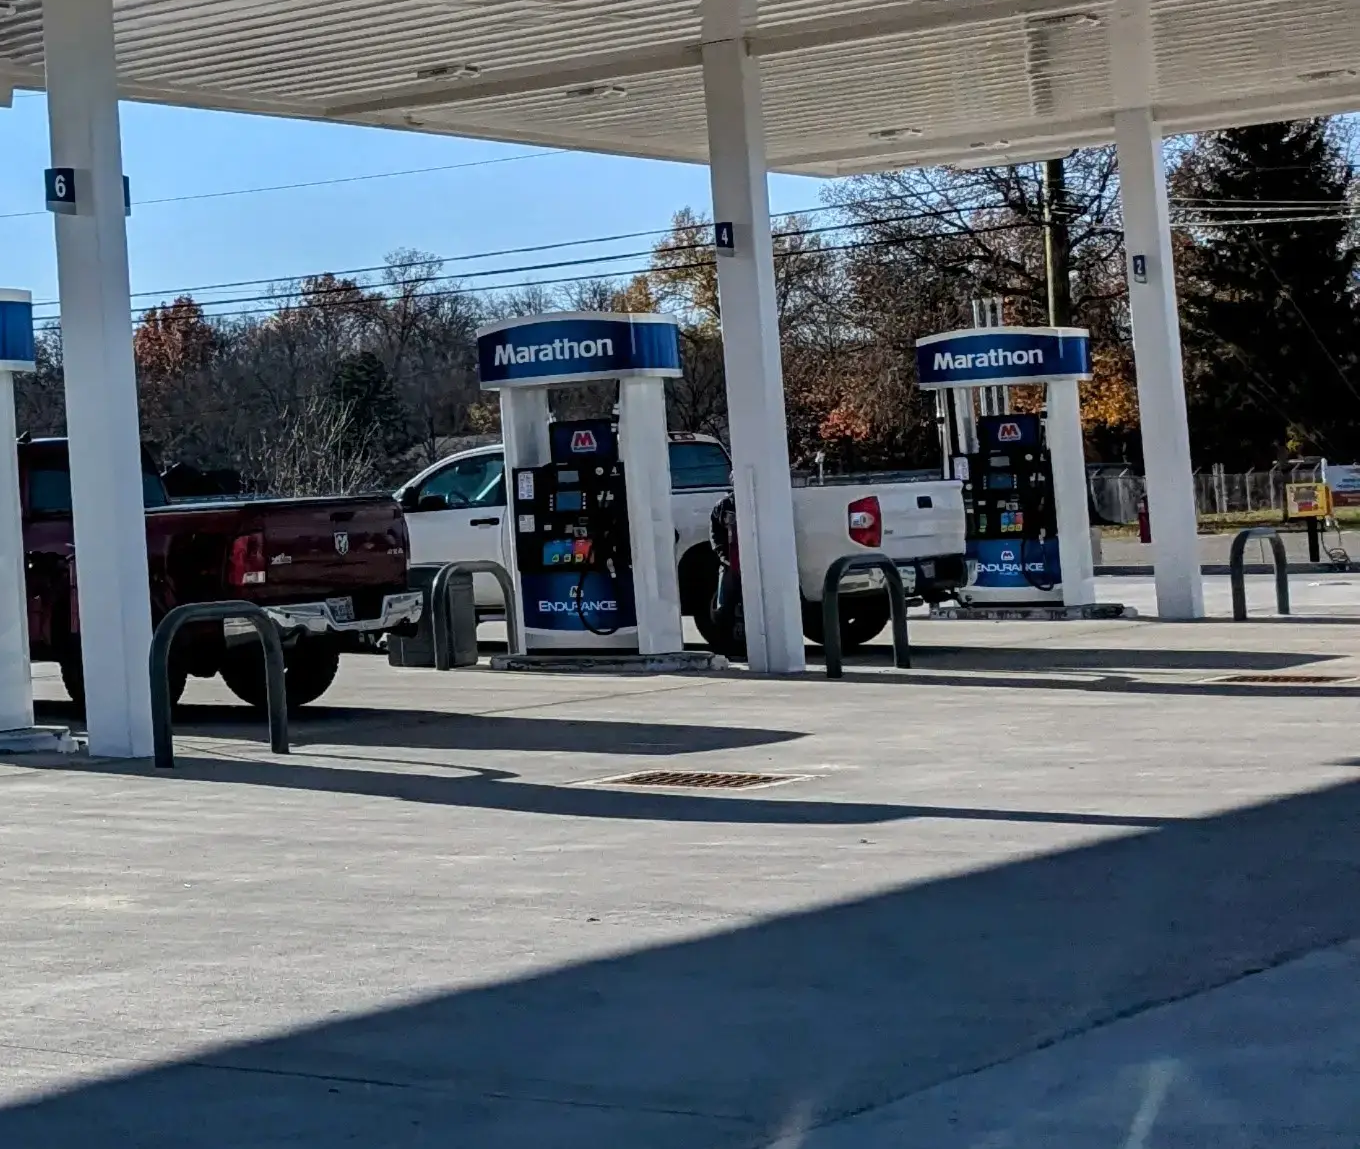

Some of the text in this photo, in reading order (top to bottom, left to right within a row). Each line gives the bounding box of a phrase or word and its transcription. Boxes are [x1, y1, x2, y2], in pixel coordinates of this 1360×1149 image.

[54, 174, 66, 198] 6
[721, 227, 729, 245] 4
[1136, 259, 1143, 274] 2
[493, 337, 614, 367] Marathon
[932, 348, 1044, 371] Marathon
